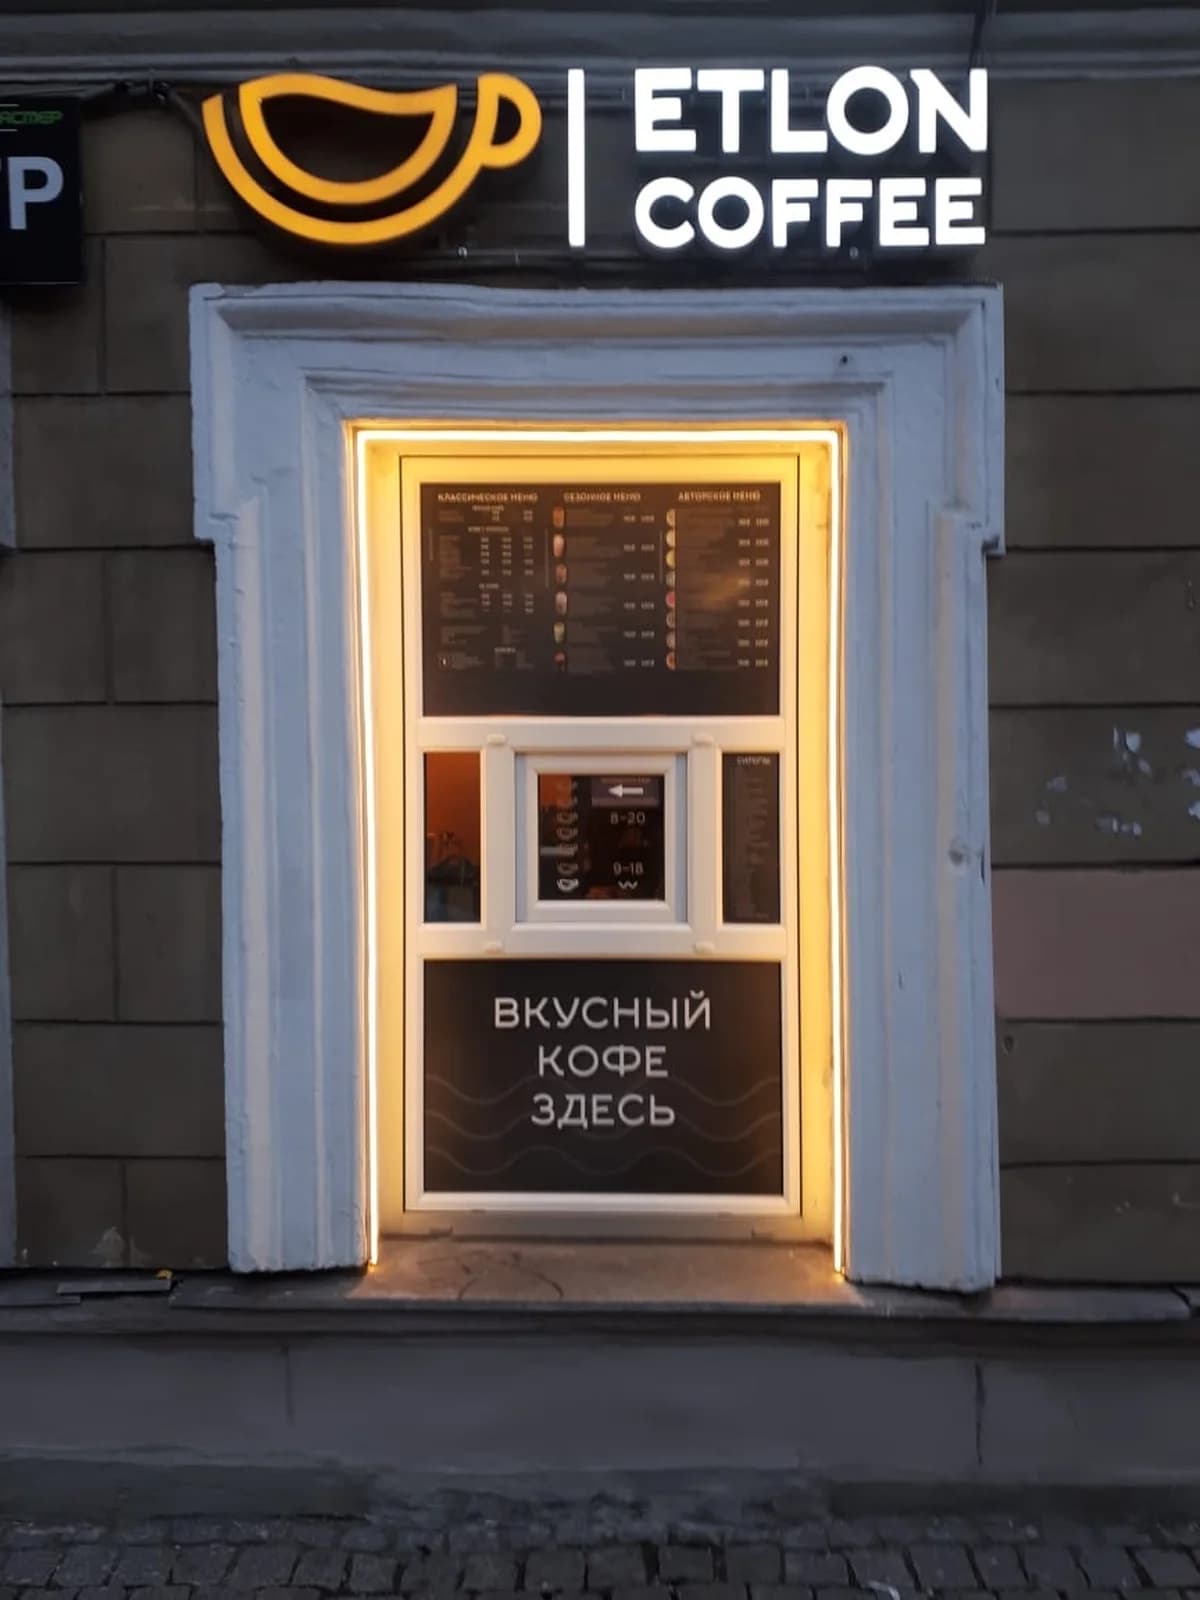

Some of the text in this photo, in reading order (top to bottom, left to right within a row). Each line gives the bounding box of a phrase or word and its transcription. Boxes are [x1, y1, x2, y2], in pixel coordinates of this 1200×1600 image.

[634, 66, 989, 156] ETLON
[634, 176, 986, 250] COFFEE
[494, 990, 711, 1030] ВКУСНЫЙ
[538, 1044, 669, 1078] КОФЕ
[531, 1093, 676, 1129] ЗДЕСЬ
